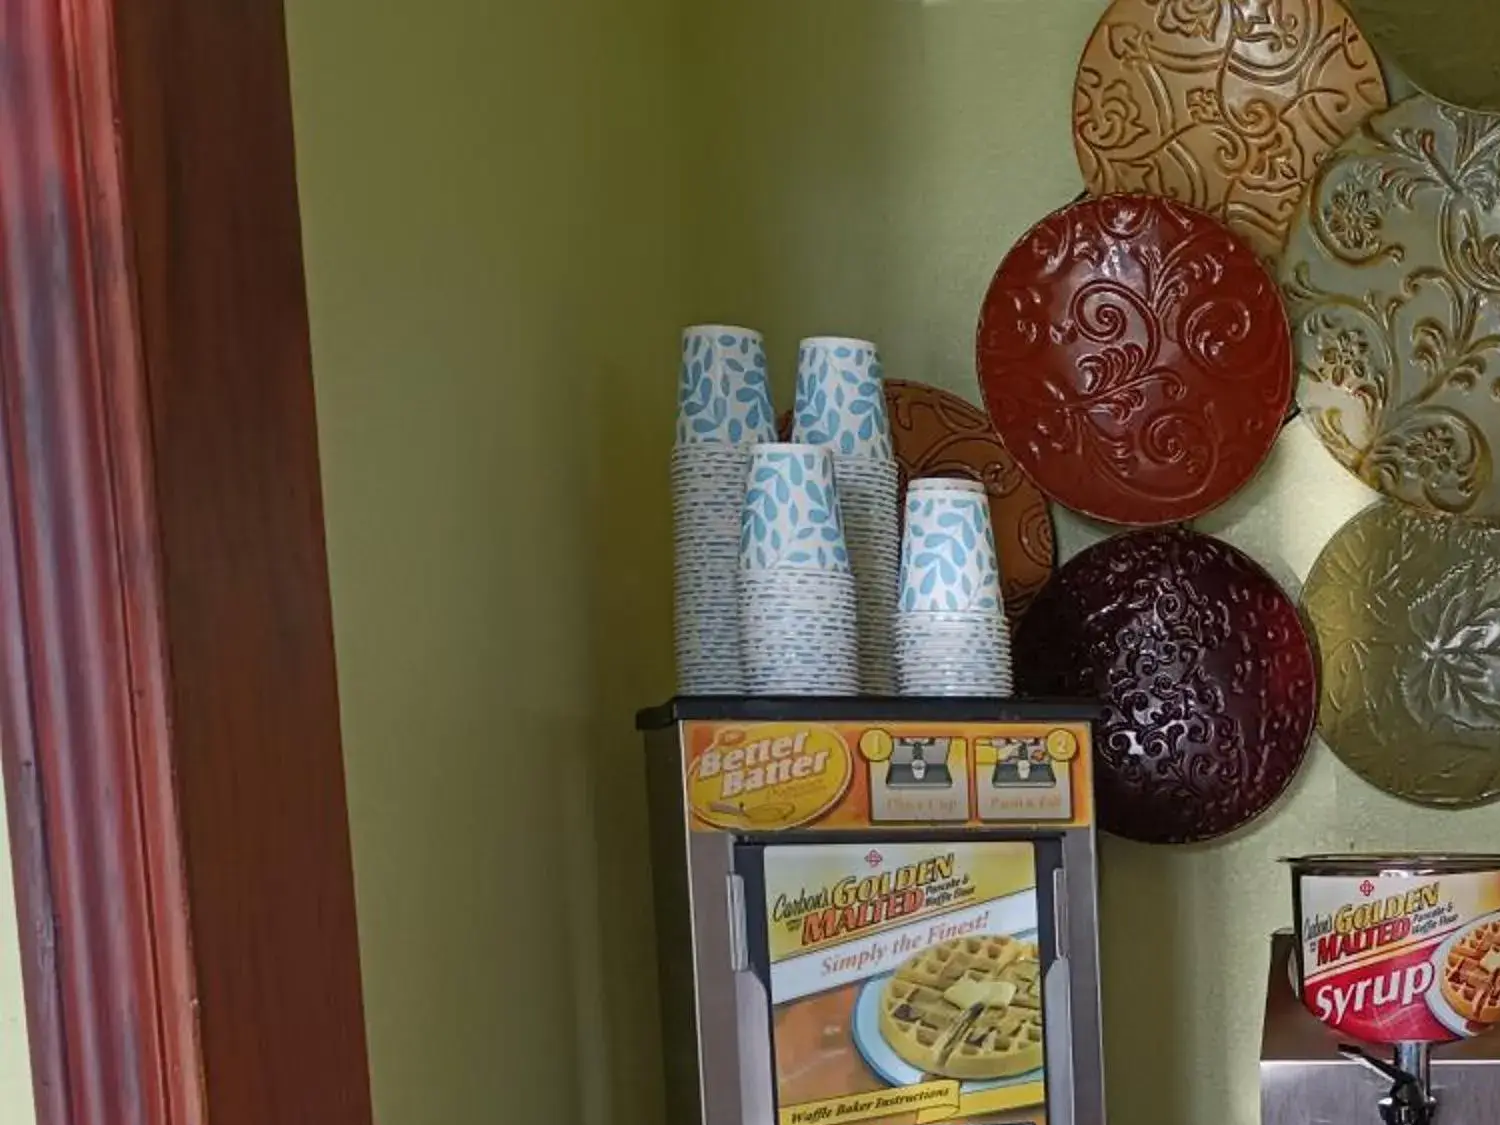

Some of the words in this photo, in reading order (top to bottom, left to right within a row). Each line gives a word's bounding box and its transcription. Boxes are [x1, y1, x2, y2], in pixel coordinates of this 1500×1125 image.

[698, 731, 811, 781] Better
[721, 750, 831, 799] Batter
[831, 853, 956, 909] GOLDEN
[800, 888, 925, 946] MALTED
[1334, 881, 1440, 933] GOLDEN
[821, 945, 887, 976] Simply
[892, 933, 922, 954] the
[926, 911, 990, 945] Finest!
[1316, 917, 1411, 967] MALTED
[791, 1106, 833, 1125] Waffle
[835, 1100, 873, 1117] Baker
[875, 1087, 950, 1109] Instructions
